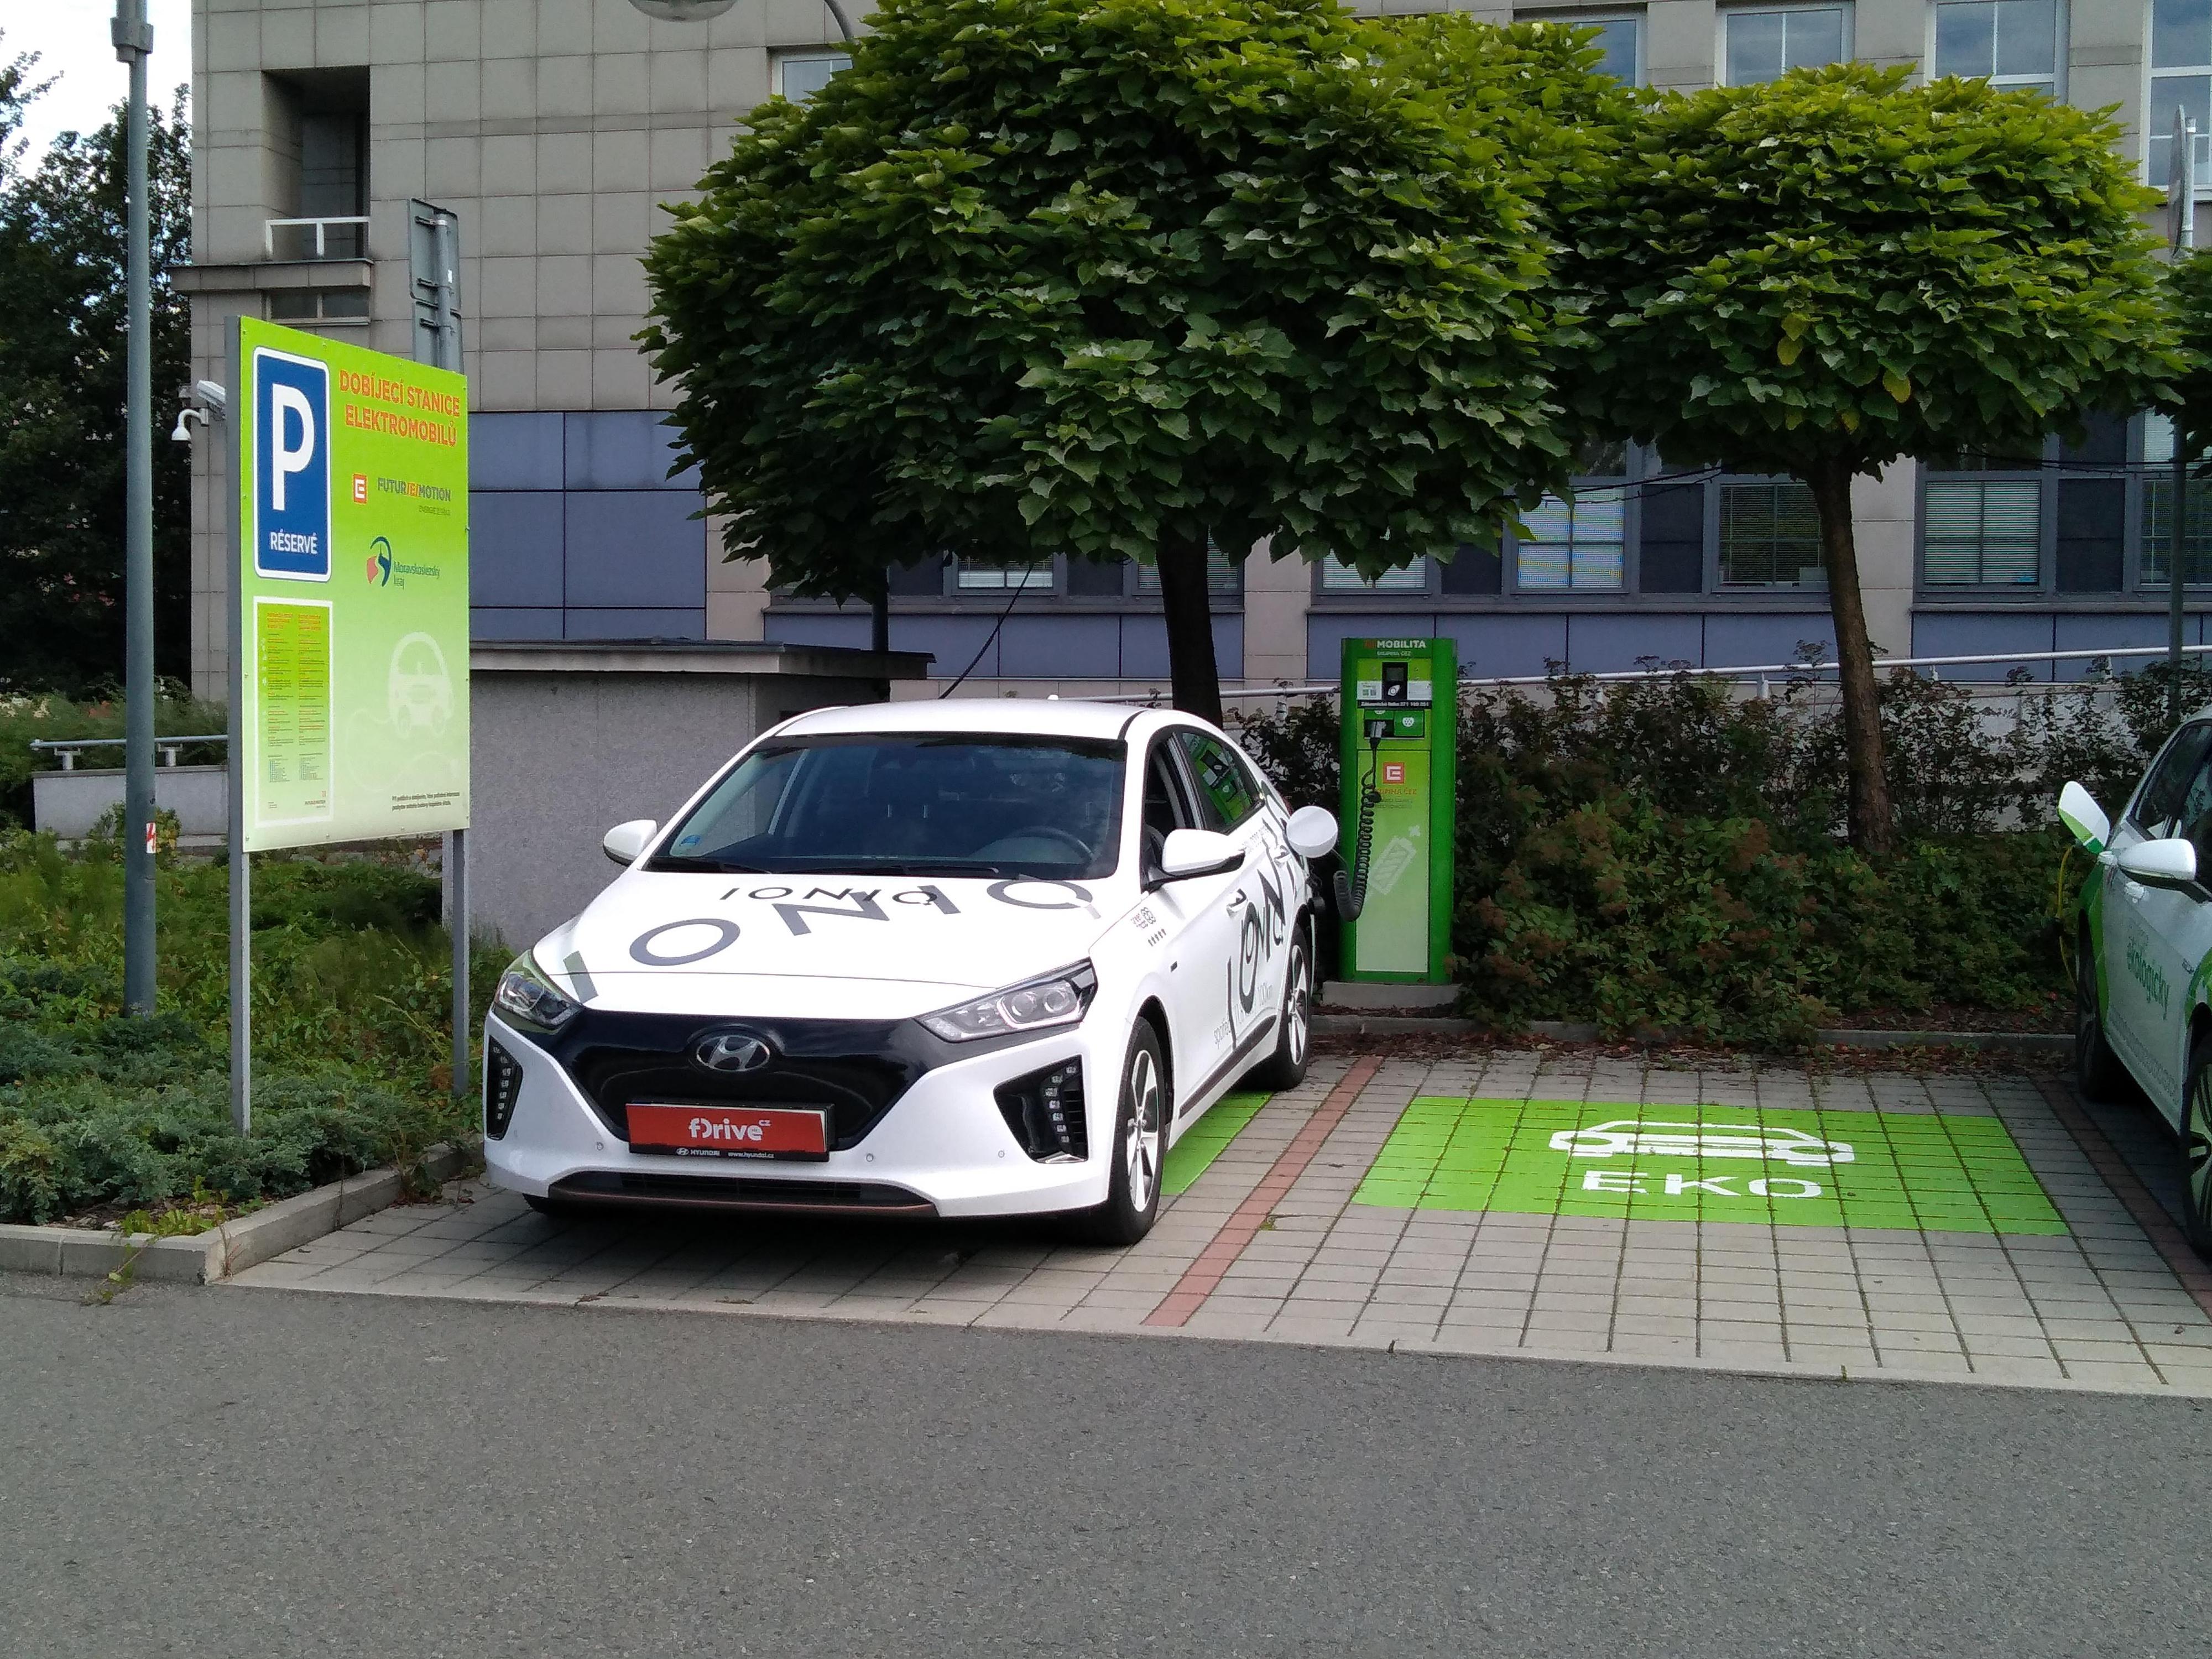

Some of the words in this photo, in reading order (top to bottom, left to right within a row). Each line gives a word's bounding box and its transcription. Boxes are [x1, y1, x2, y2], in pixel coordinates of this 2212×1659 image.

[340, 370, 404, 404] DOBÍJECÍ
[407, 386, 460, 417] STANICE
[345, 404, 457, 447] ELEKTROMOBILŮ
[273, 384, 315, 511] P
[270, 528, 318, 555] RÉSERVÉ
[719, 886, 939, 907] IONIQ
[563, 874, 1102, 1004] IONIQ
[1582, 1170, 1822, 1198] EKO
